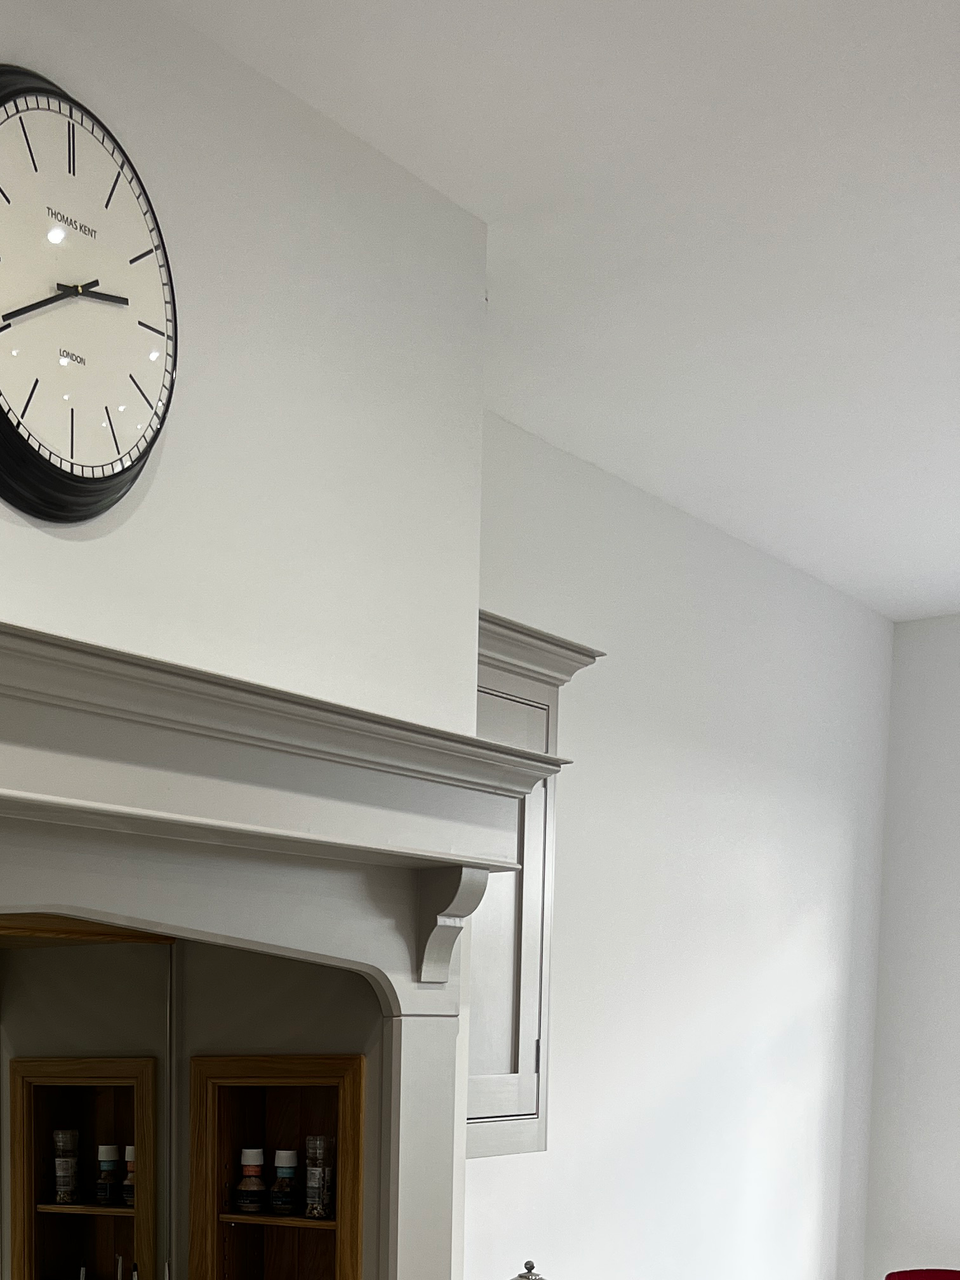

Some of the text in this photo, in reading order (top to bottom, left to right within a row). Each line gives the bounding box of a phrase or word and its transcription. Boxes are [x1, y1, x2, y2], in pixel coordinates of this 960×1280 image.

[46, 206, 97, 239] THOMAS KENT
[59, 348, 86, 366] LONDON
